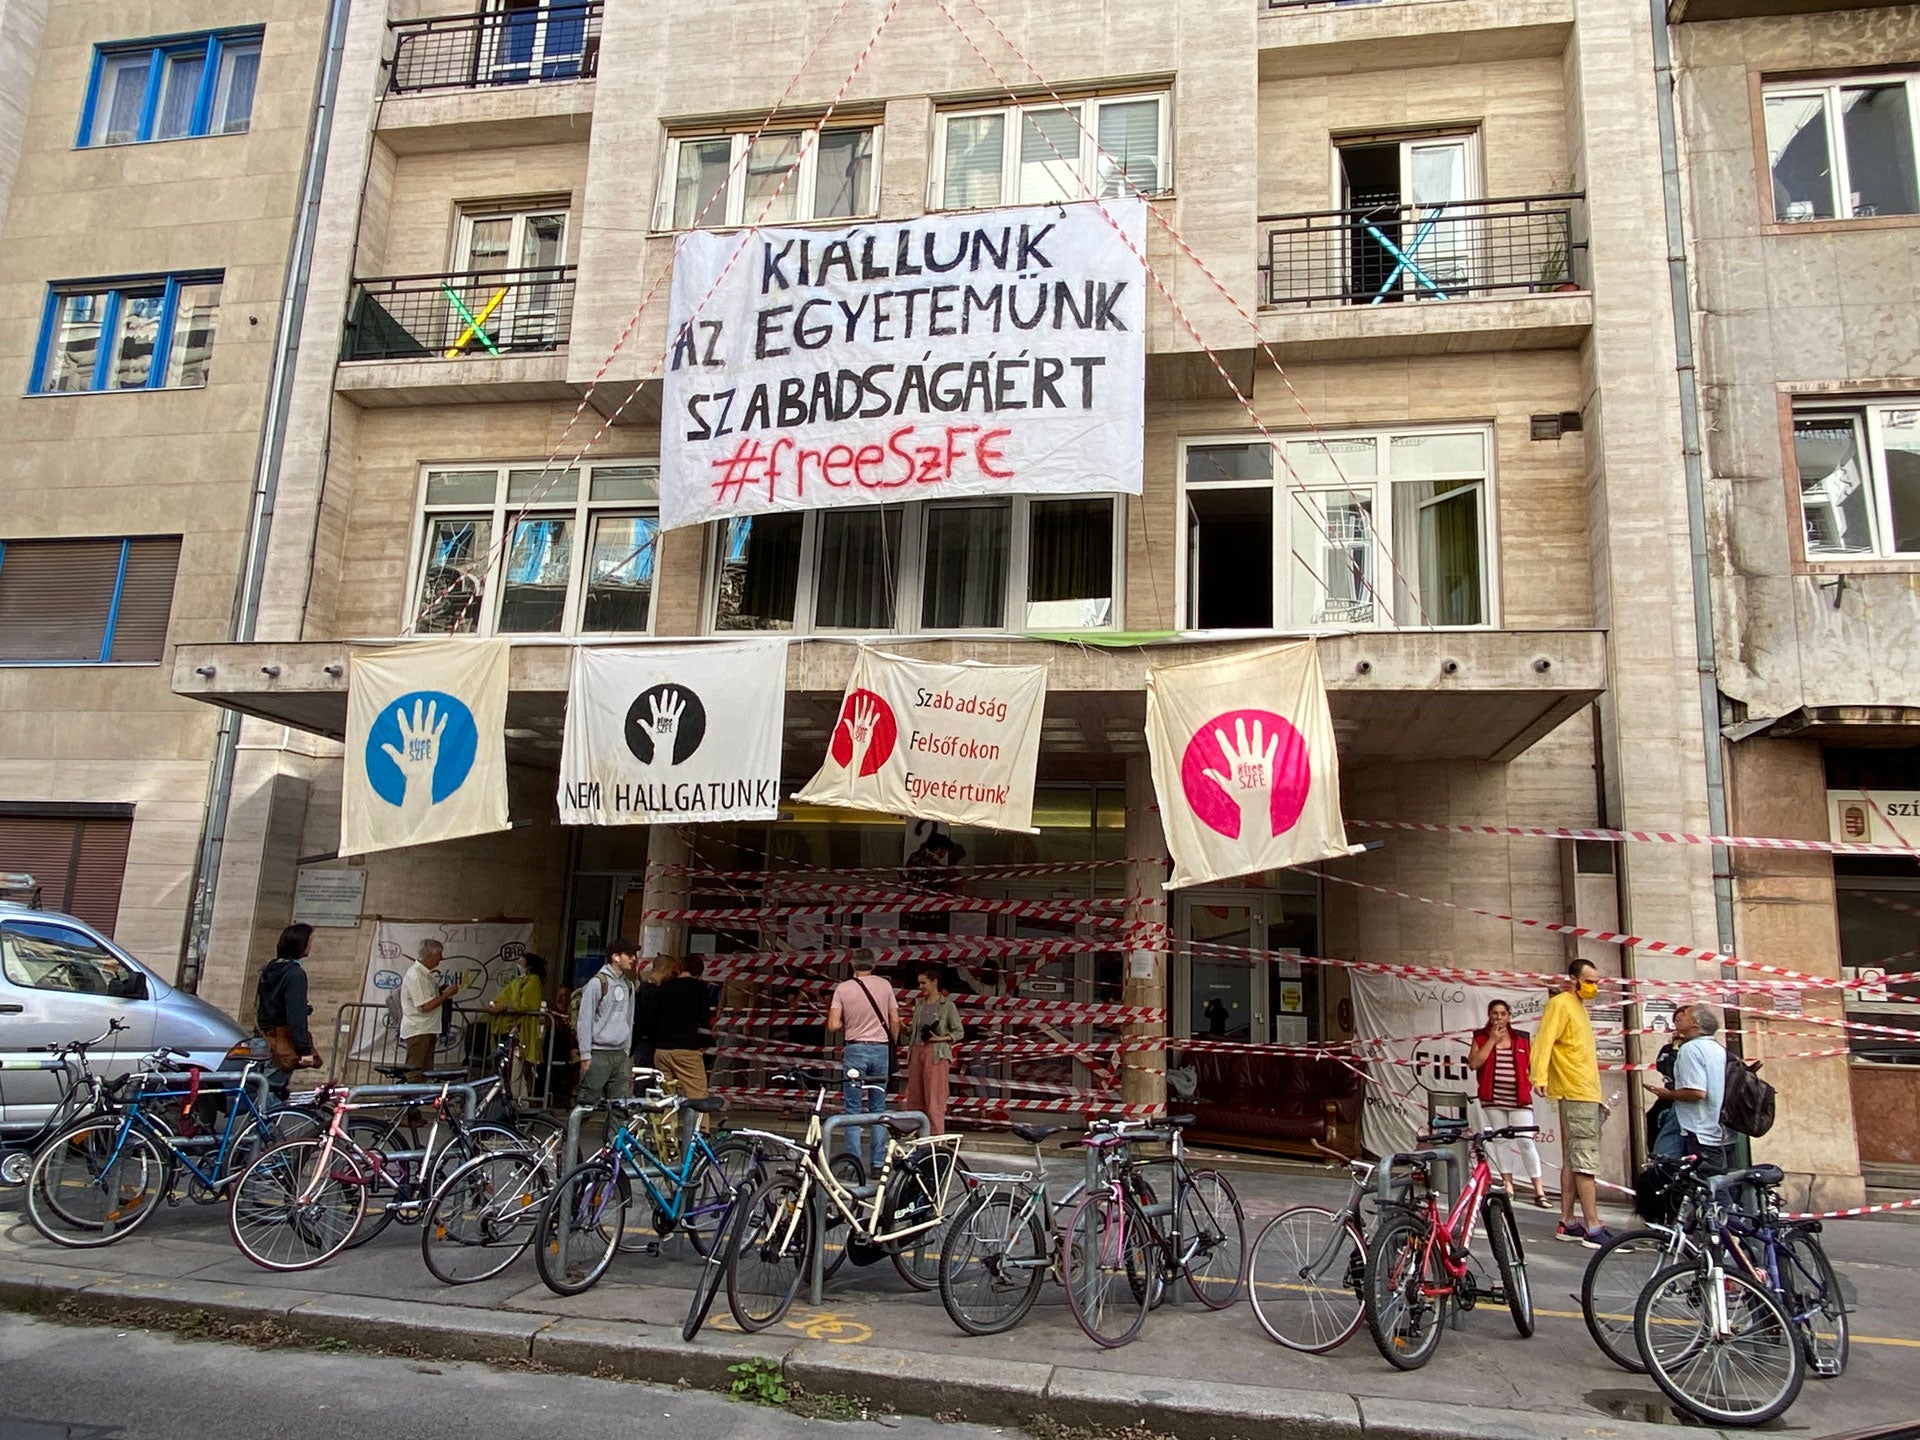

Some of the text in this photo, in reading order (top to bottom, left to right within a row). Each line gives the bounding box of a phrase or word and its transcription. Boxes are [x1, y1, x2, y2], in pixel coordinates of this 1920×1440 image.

[762, 223, 1056, 294] KIÁLLUNK
[671, 319, 725, 370] AZ
[687, 349, 1106, 441] SZABADSÁGÁÉRT
[711, 426, 1014, 504] #freeSzFE
[915, 687, 1007, 722] Szabadság
[909, 730, 1000, 760] Felsőfokon
[565, 779, 778, 811] NEM HALLGATUNK!
[904, 772, 1010, 805] Egyetértünk!
[1239, 773, 1266, 789] SZFE
[1887, 800, 1920, 816] SZÍ
[1413, 986, 1465, 1004] VÁGÓ
